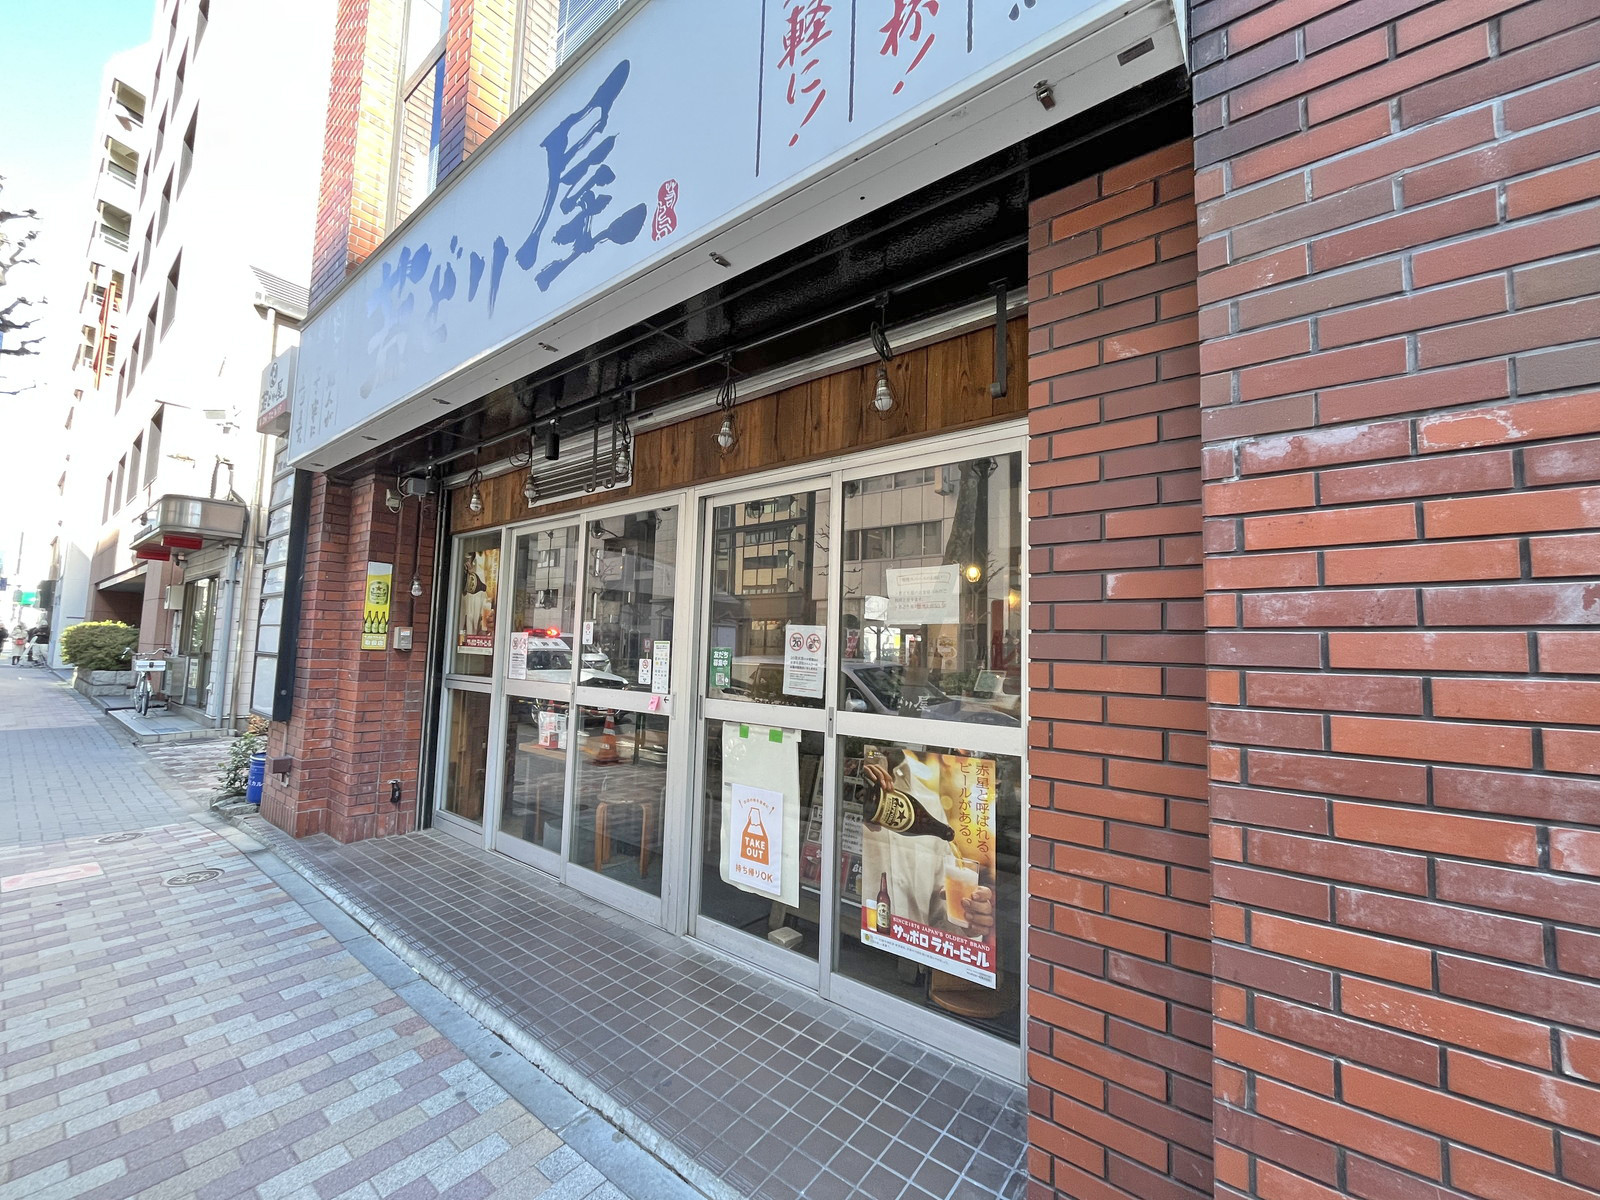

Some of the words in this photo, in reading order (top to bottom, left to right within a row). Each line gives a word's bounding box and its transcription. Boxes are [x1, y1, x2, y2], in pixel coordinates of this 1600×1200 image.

[777, 0, 833, 147] 軽に!
[792, 639, 802, 648] 20
[713, 651, 729, 659] 友だち
[713, 659, 728, 667] 募集中
[958, 762, 973, 845] ビールがある。
[975, 763, 991, 862] 赤星と呼ばれる、
[744, 836, 766, 851] TAKE
[746, 849, 764, 860] OUT
[735, 863, 773, 884] 持ち帰りOK
[892, 923, 929, 949] サッポロ
[930, 937, 990, 968] ラガービール
[921, 926, 944, 938] JAPAN'S
[945, 932, 968, 945] OLDEST
[969, 940, 991, 952] BRAND
